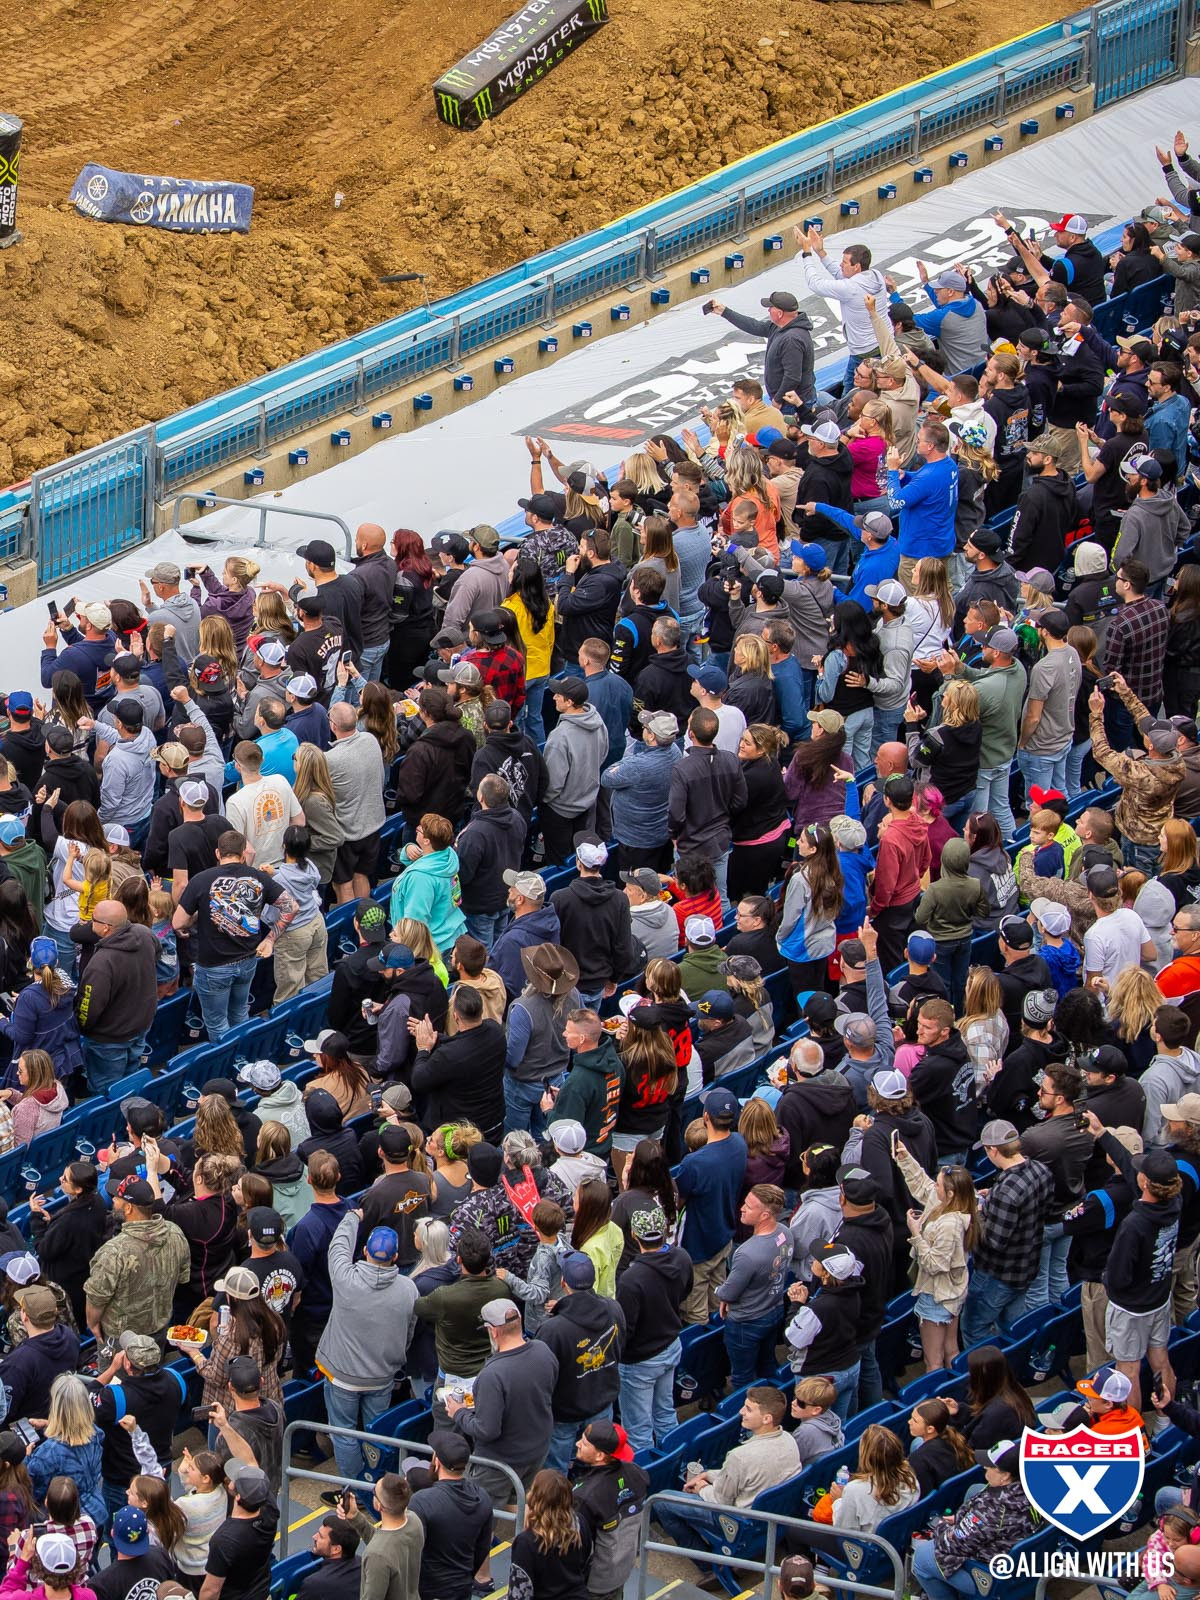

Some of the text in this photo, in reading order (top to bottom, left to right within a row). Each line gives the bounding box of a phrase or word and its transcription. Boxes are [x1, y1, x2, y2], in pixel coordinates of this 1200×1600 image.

[498, 9, 556, 61] ENERGY
[498, 13, 584, 93] MONSTER
[515, 39, 573, 93] ENERGY
[1, 187, 12, 226] MOTO
[74, 191, 103, 219] YAMAHA
[156, 193, 237, 224] YAMAHA
[316, 636, 342, 659] SEXTON
